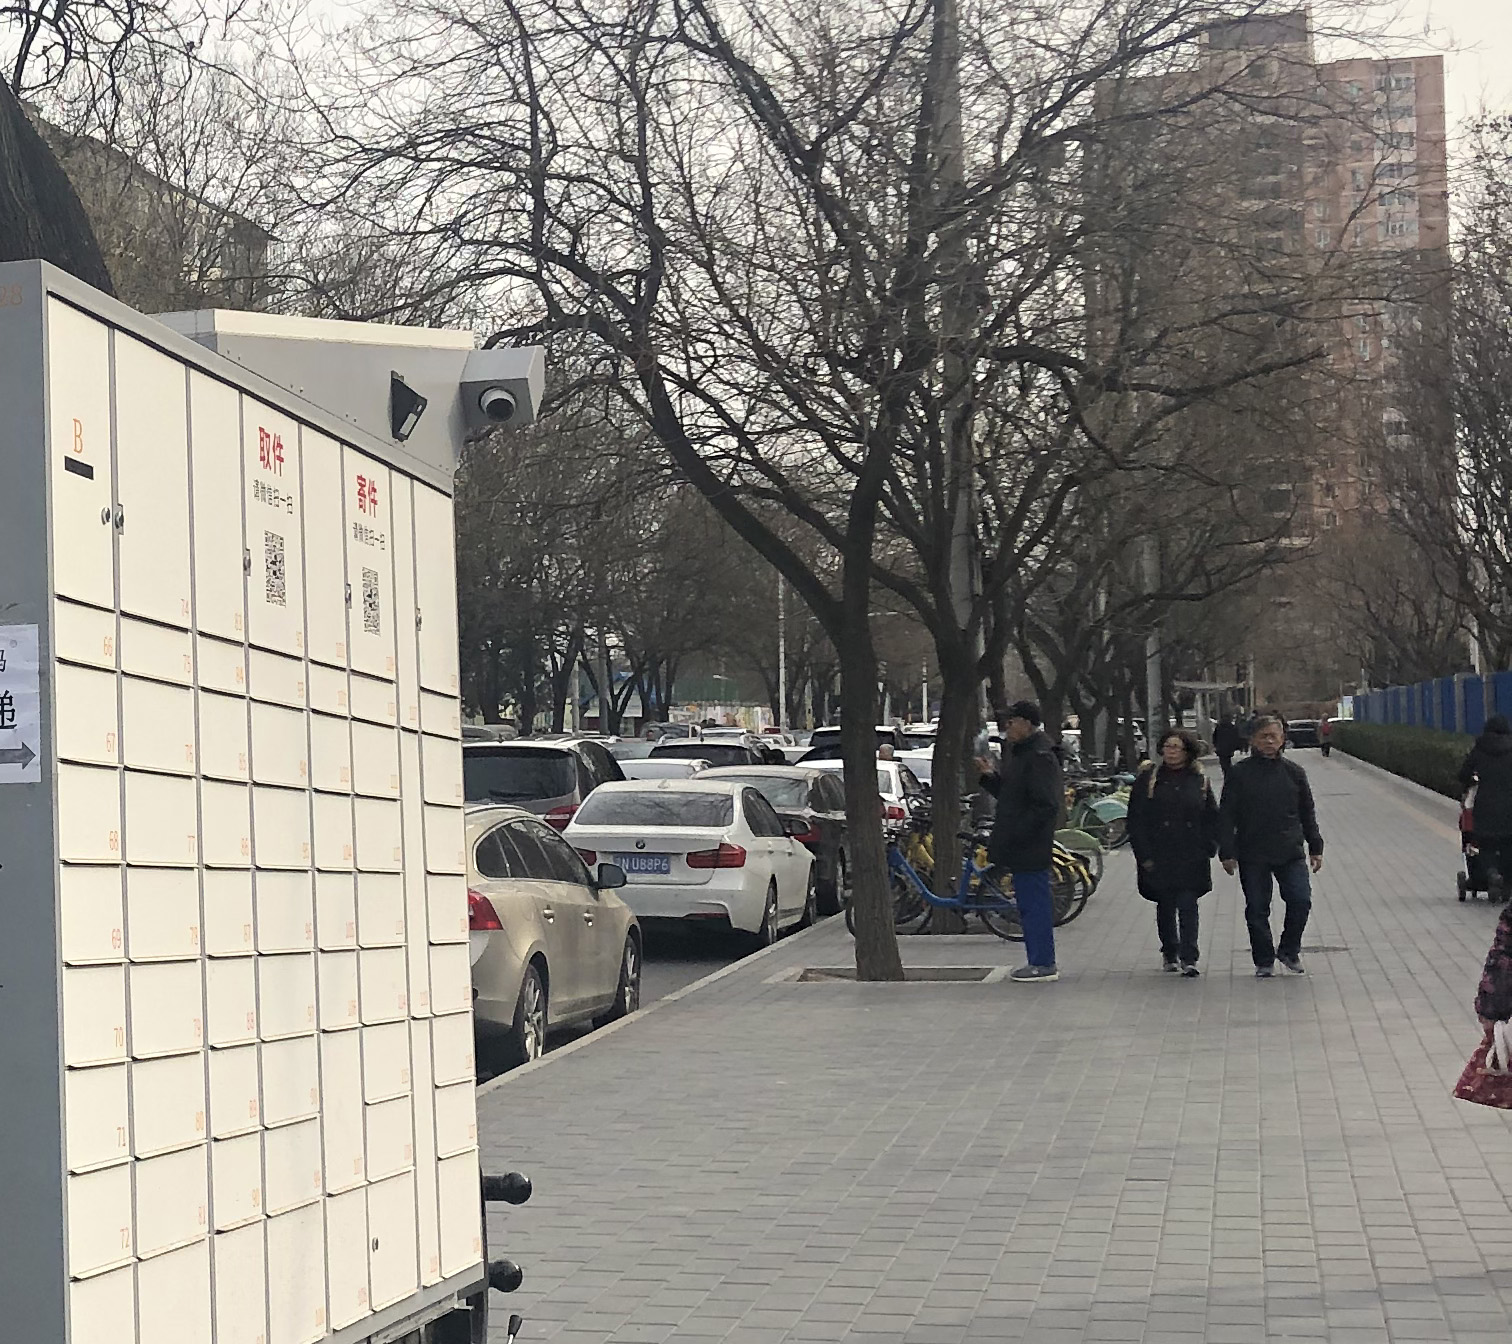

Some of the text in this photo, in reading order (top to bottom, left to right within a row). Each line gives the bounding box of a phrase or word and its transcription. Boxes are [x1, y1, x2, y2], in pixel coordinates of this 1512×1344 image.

[73, 418, 83, 453] B
[258, 426, 285, 477] 取件
[356, 474, 378, 518] 寄件
[104, 637, 113, 656] 66
[107, 732, 116, 752] 67
[110, 831, 119, 850] 68
[112, 928, 121, 949] 69
[114, 1027, 124, 1048] 70
[117, 1127, 126, 1147] 71
[120, 1227, 130, 1249] 72
